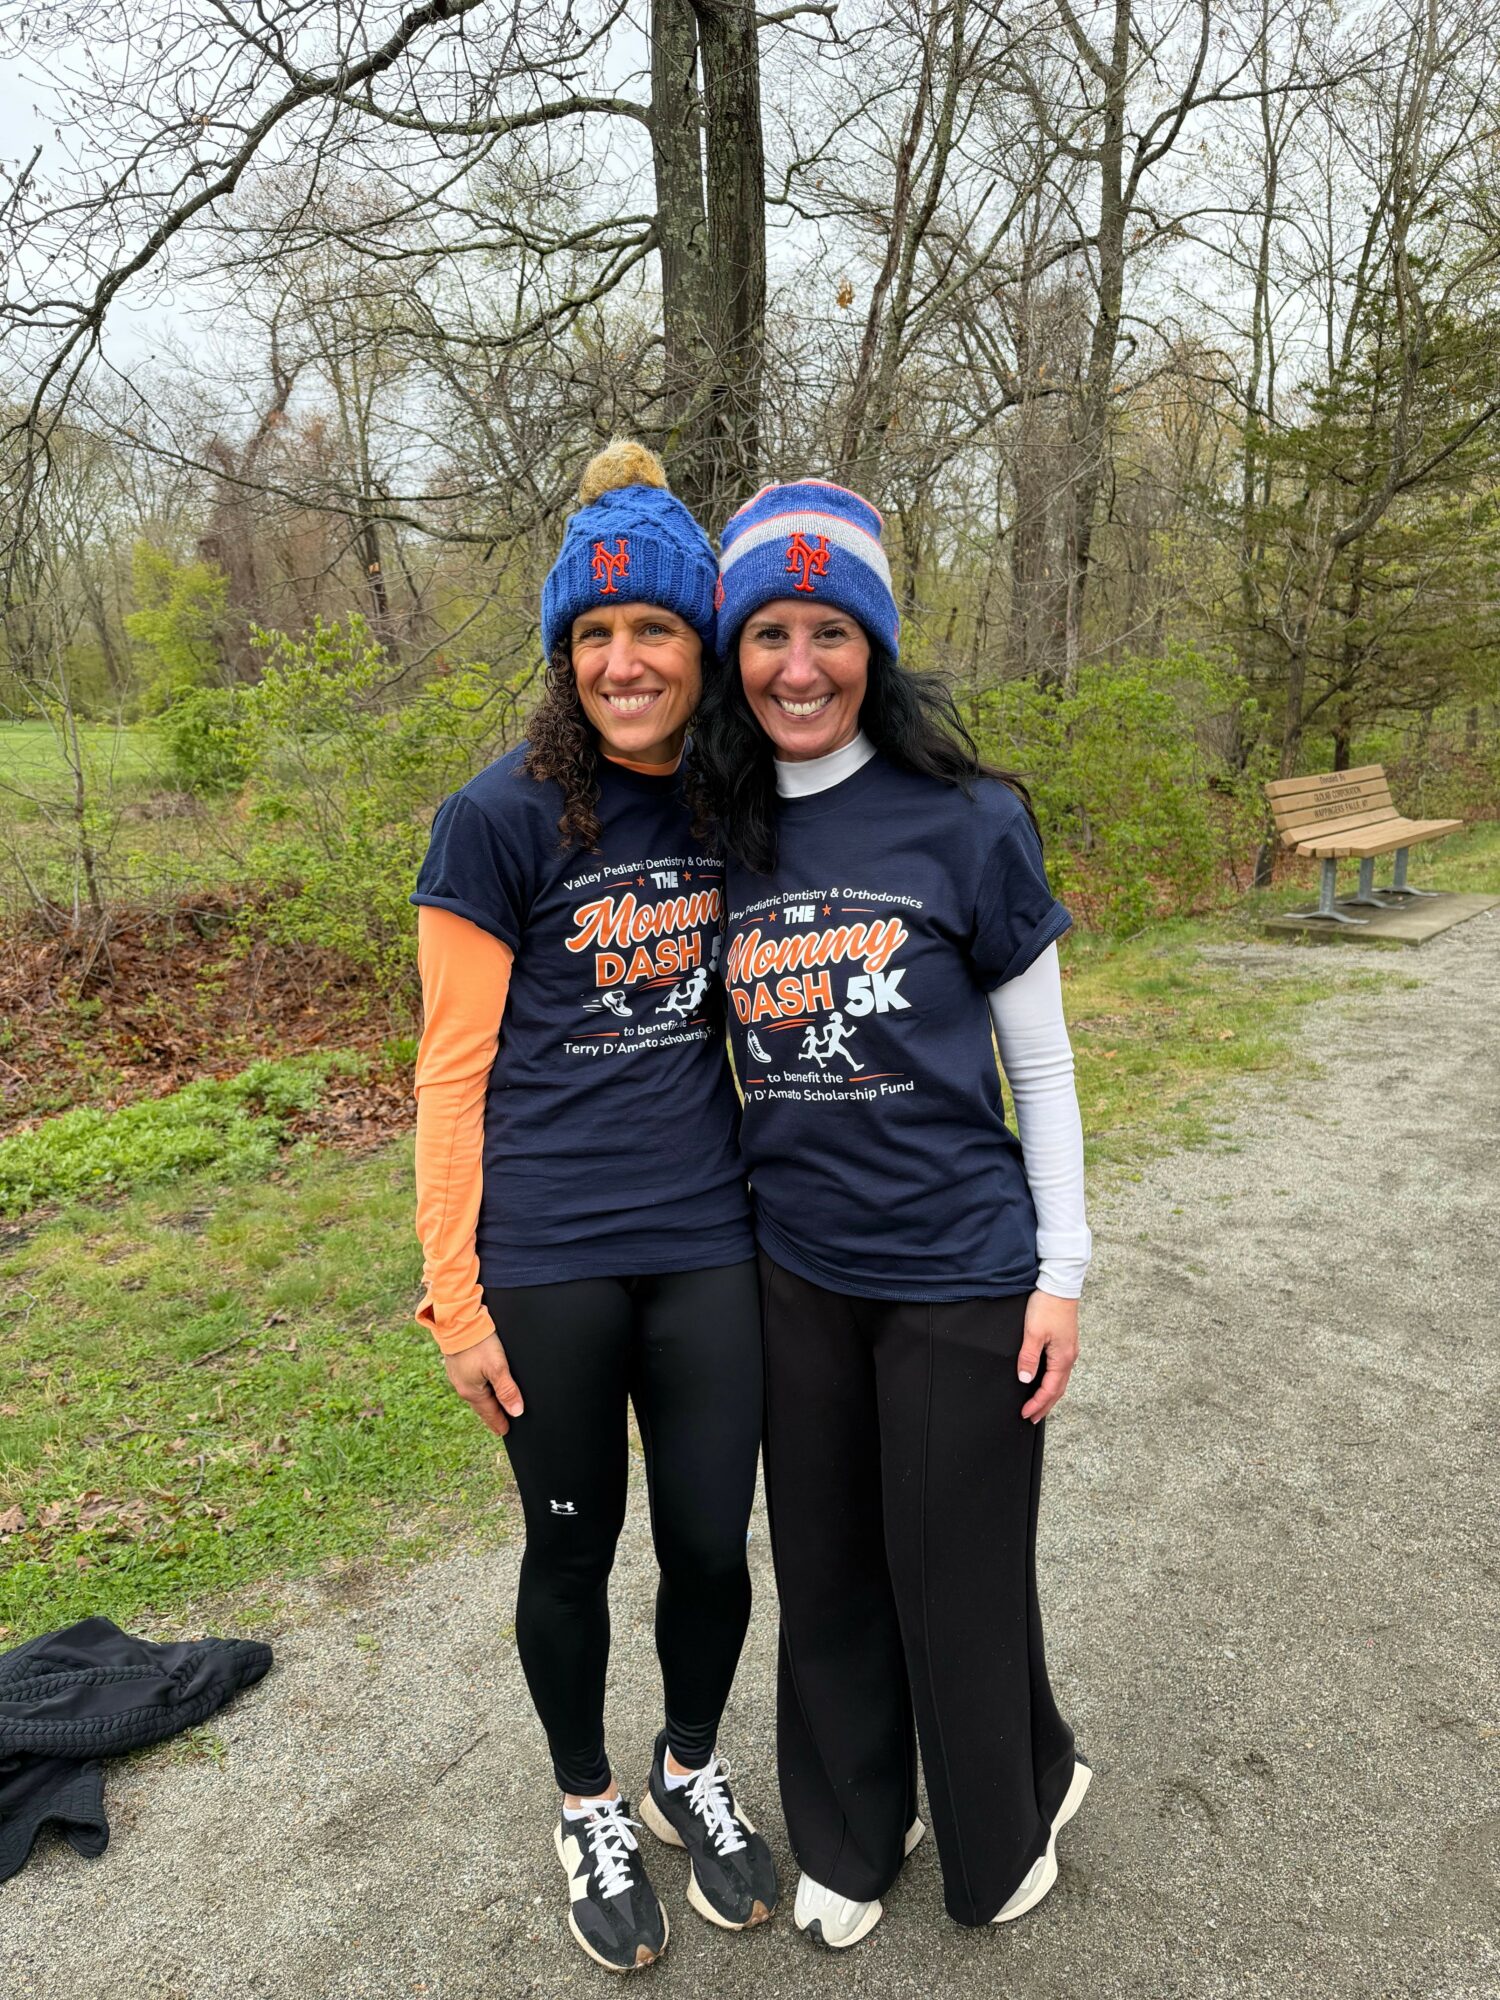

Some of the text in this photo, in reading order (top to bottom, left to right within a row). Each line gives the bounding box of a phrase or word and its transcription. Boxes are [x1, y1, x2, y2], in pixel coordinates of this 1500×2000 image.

[563, 872, 601, 891] Valley
[645, 856, 686, 870] Dentistry
[687, 857, 695, 866] &
[651, 871, 679, 890] THE
[745, 896, 782, 916] Pediatric
[782, 890, 827, 904] Dentistry
[830, 887, 839, 898] &
[842, 888, 924, 909] Orthodontics
[783, 905, 816, 925] THE
[595, 931, 702, 988] DASH
[725, 917, 909, 992] Mommy
[731, 968, 912, 1025] DASH 5K
[563, 1042, 600, 1056] Terry
[603, 1038, 658, 1054] D'Amato
[659, 1029, 708, 1047] Scholarshp
[623, 1027, 634, 1037] to
[754, 1089, 802, 1101] D'Amato
[803, 1088, 877, 1101] Scholarship
[880, 1080, 915, 1096] Fund
[767, 1070, 844, 1084] to benefit the
